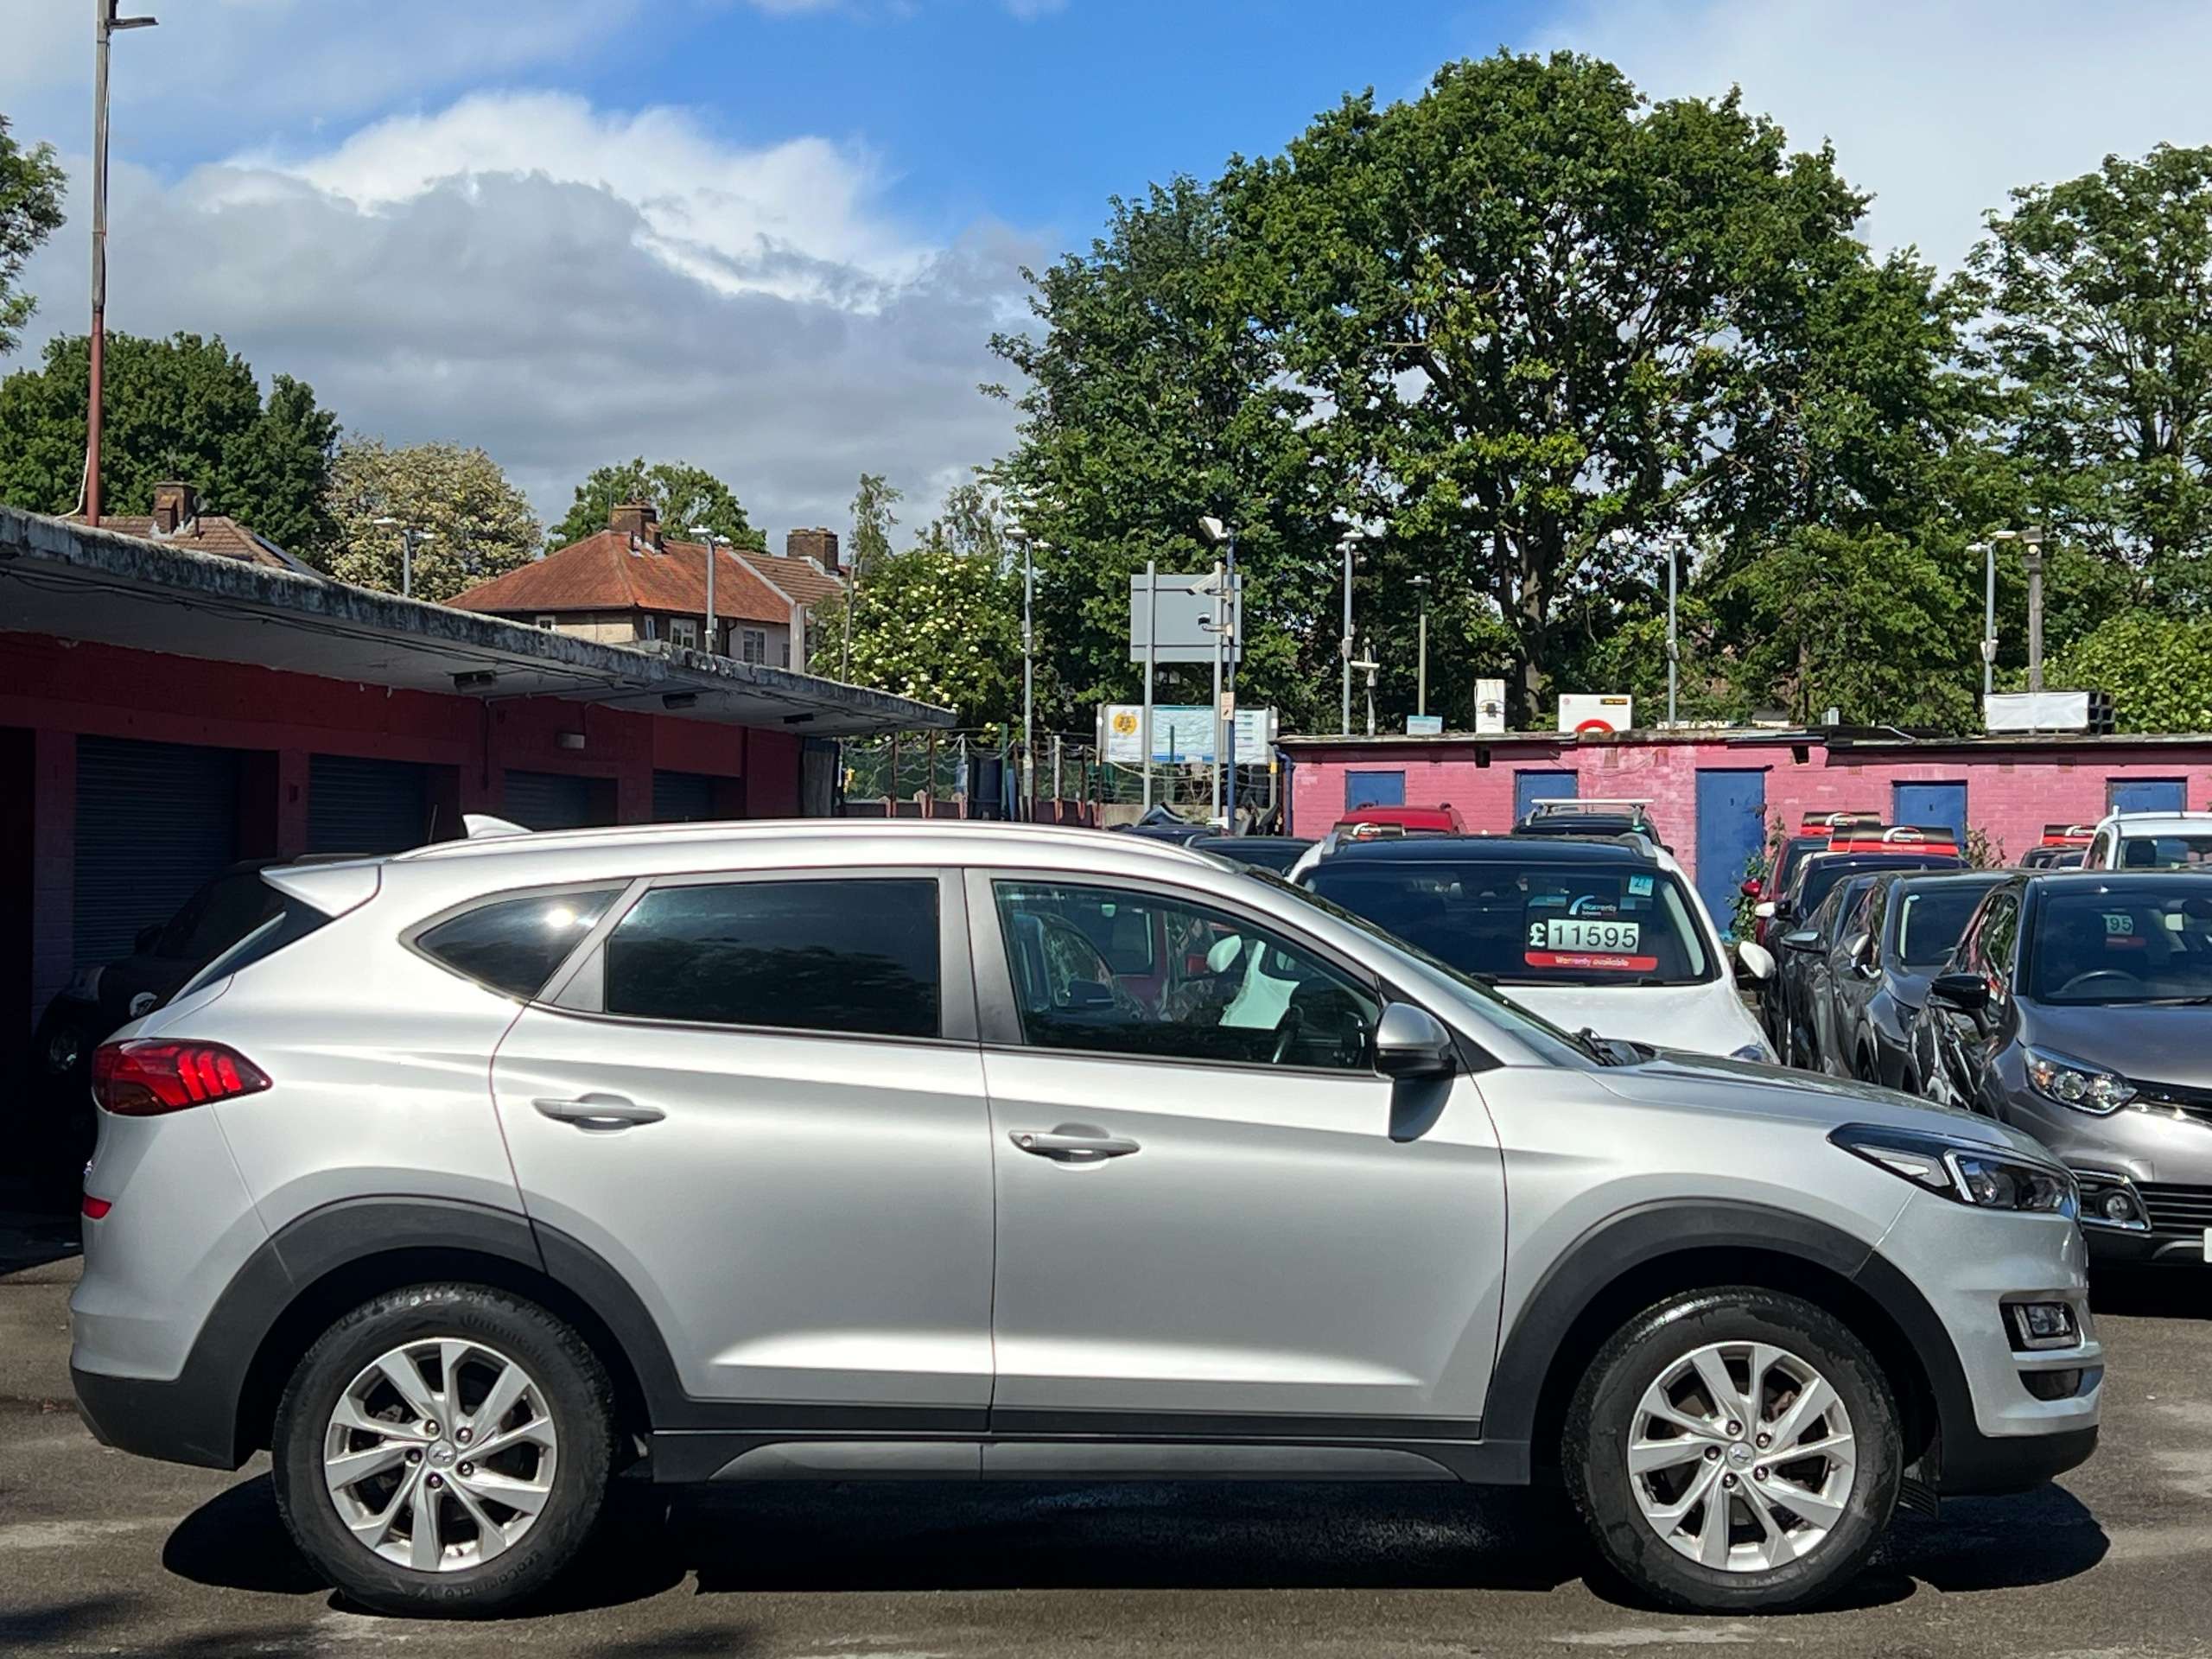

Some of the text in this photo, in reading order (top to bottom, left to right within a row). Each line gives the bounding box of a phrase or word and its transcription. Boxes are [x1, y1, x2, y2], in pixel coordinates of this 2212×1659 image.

[1529, 922, 1637, 948] £11595
[1555, 955, 1630, 967] Warranty available
